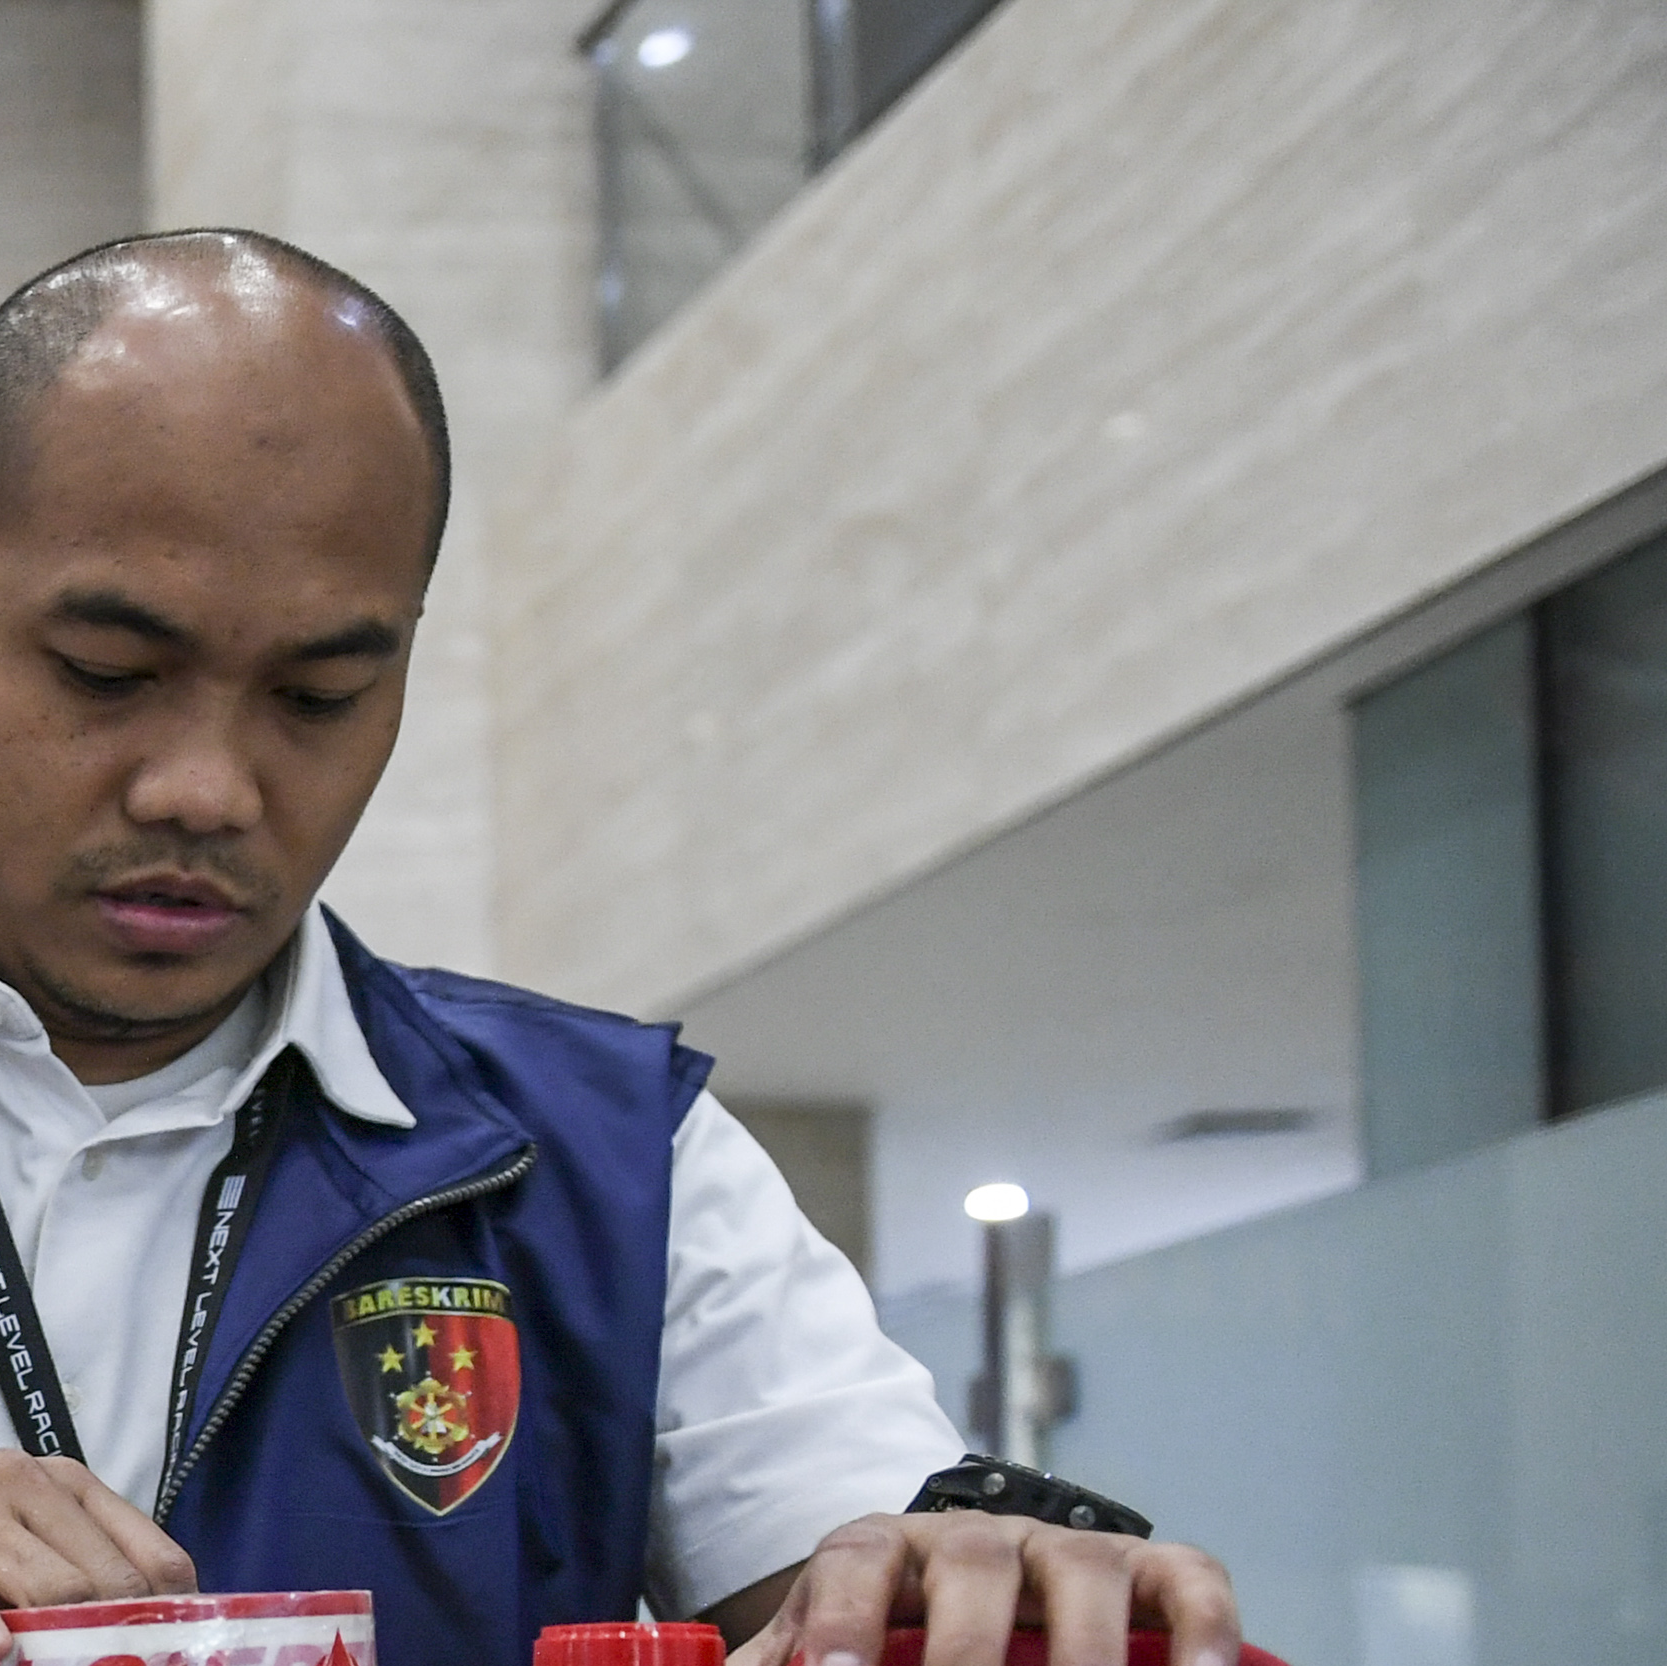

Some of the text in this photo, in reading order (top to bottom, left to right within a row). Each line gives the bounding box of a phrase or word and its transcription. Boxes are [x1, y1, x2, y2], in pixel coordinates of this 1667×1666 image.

[202, 1208, 233, 1286] NEXT
[178, 1290, 214, 1388] LEVEL
[347, 1285, 506, 1320] BARESKRIM
